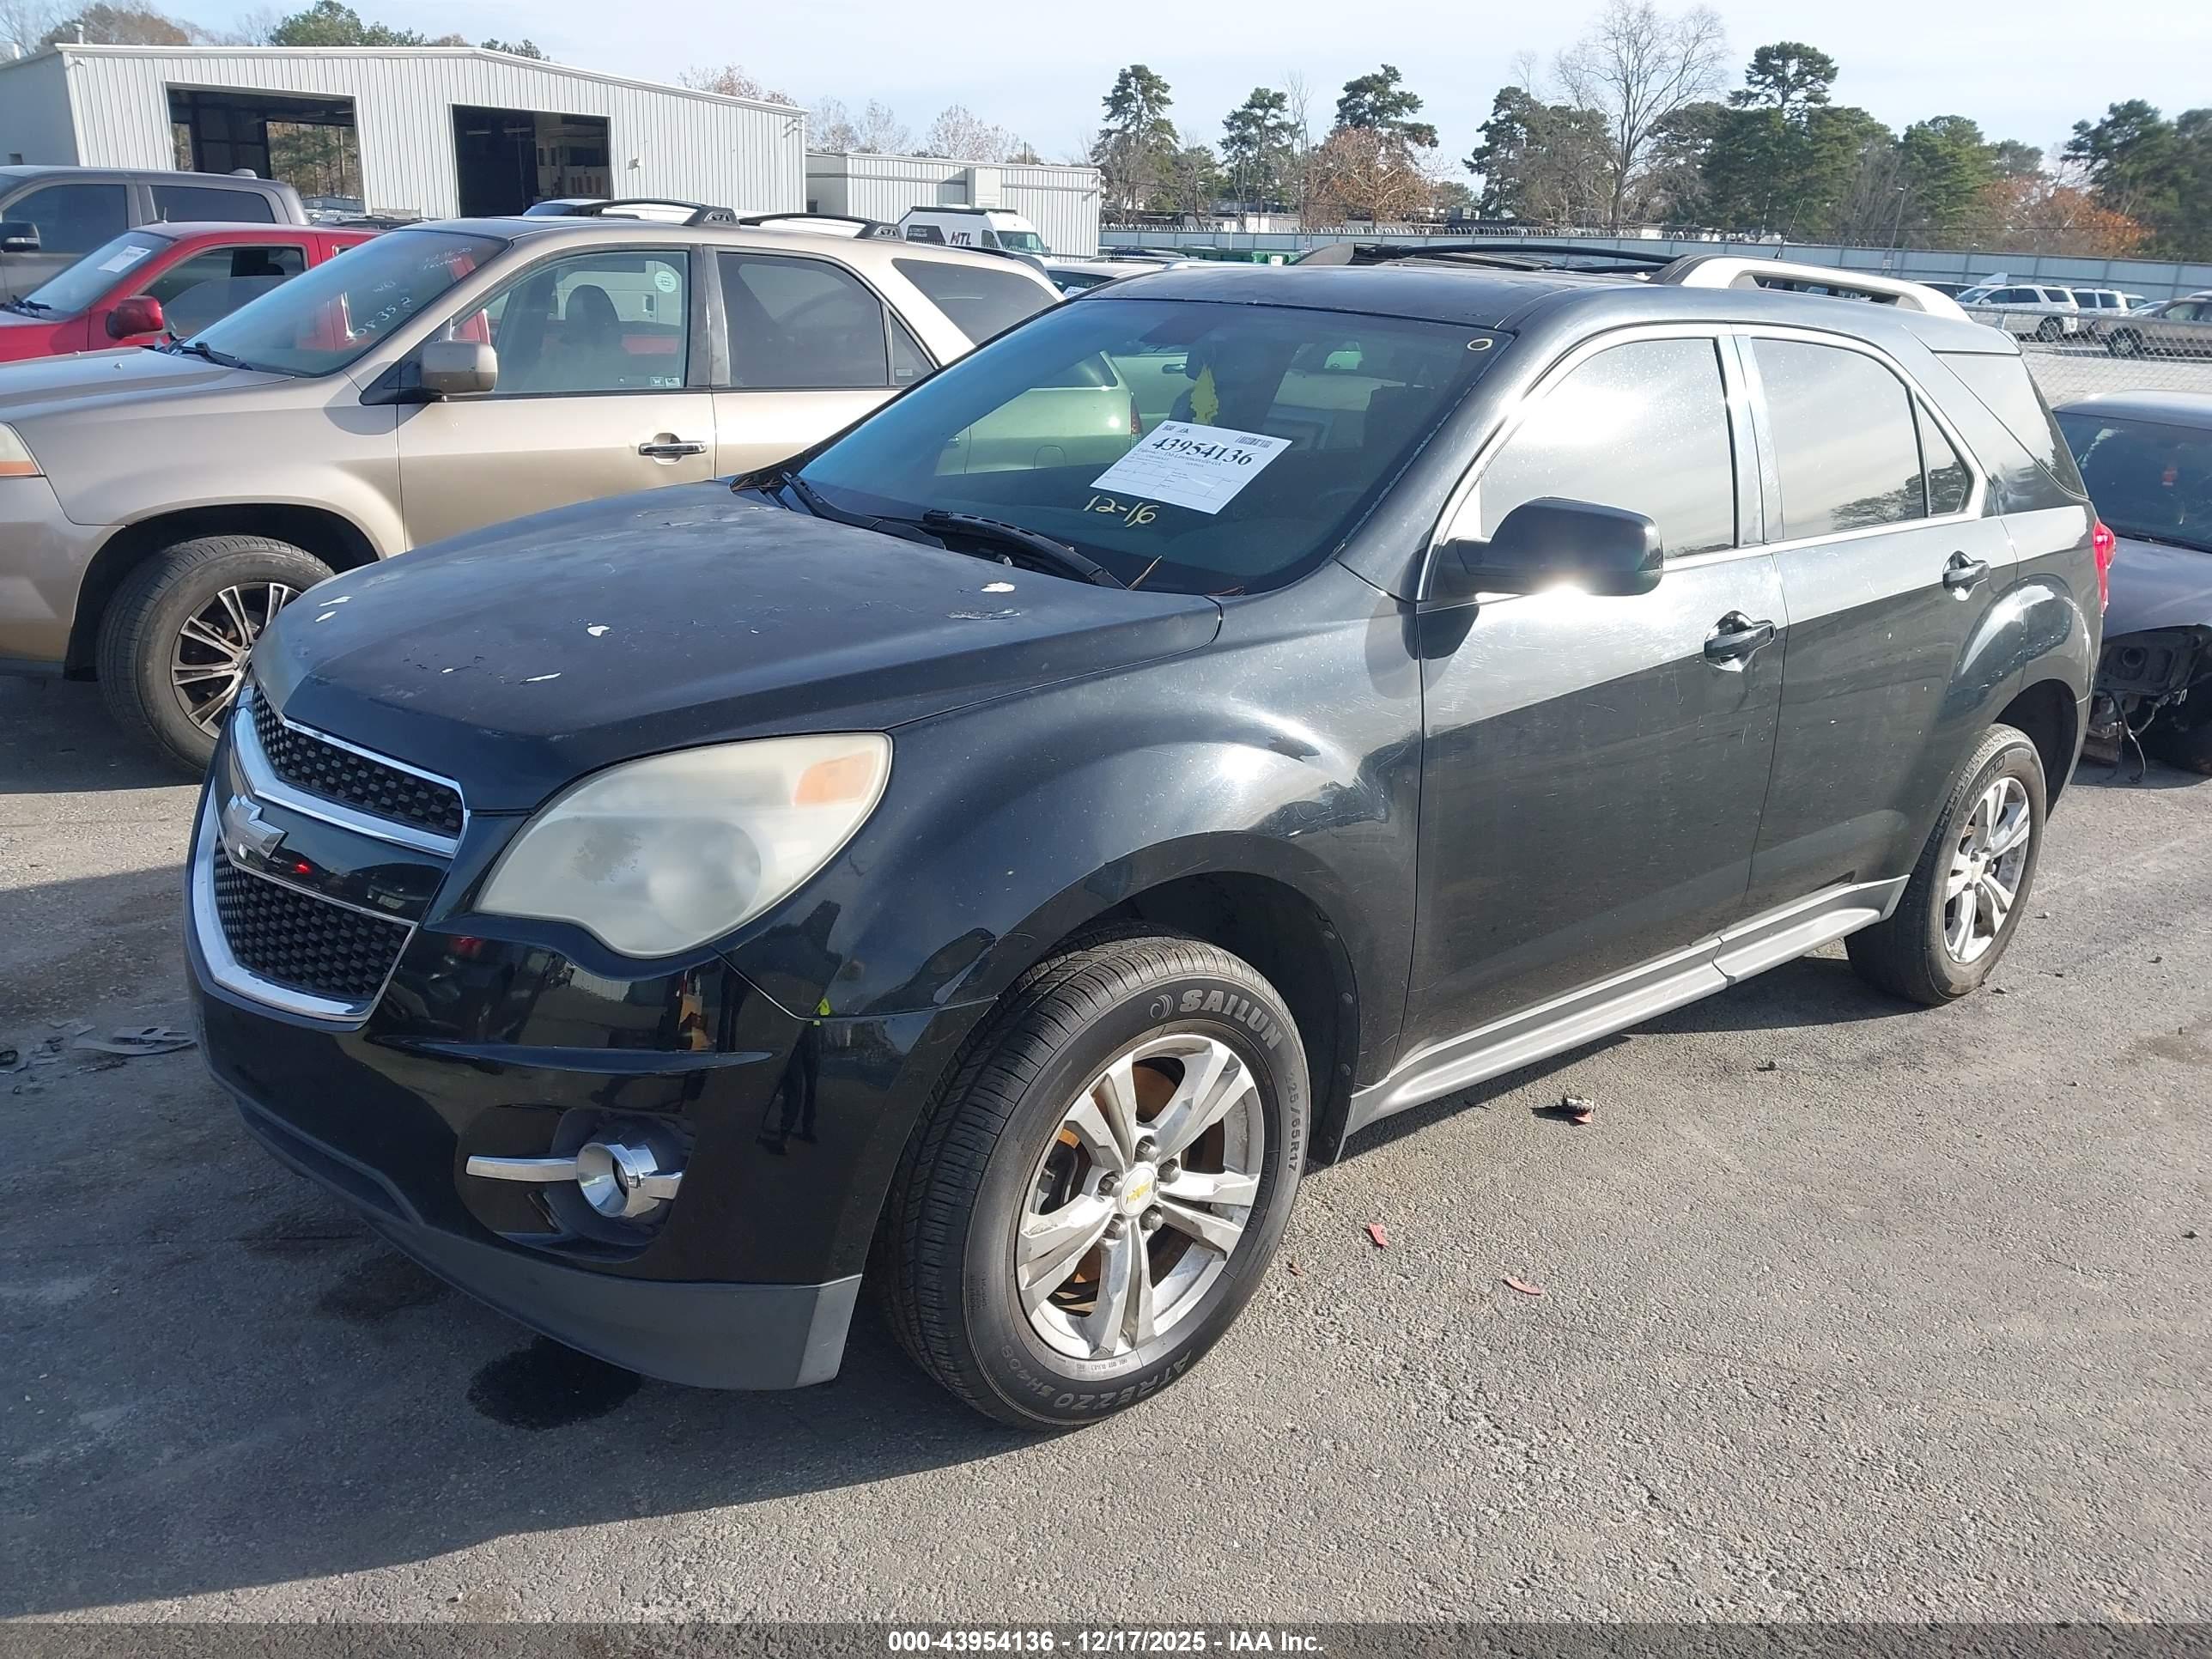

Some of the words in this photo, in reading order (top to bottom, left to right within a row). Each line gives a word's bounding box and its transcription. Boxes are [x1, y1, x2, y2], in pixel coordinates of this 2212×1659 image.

[1152, 437, 1258, 466] 43954136
[1083, 495, 1160, 528] 12-16
[1179, 989, 1285, 1050] SAILUN
[1053, 1349, 1193, 1412] ATREZZO
